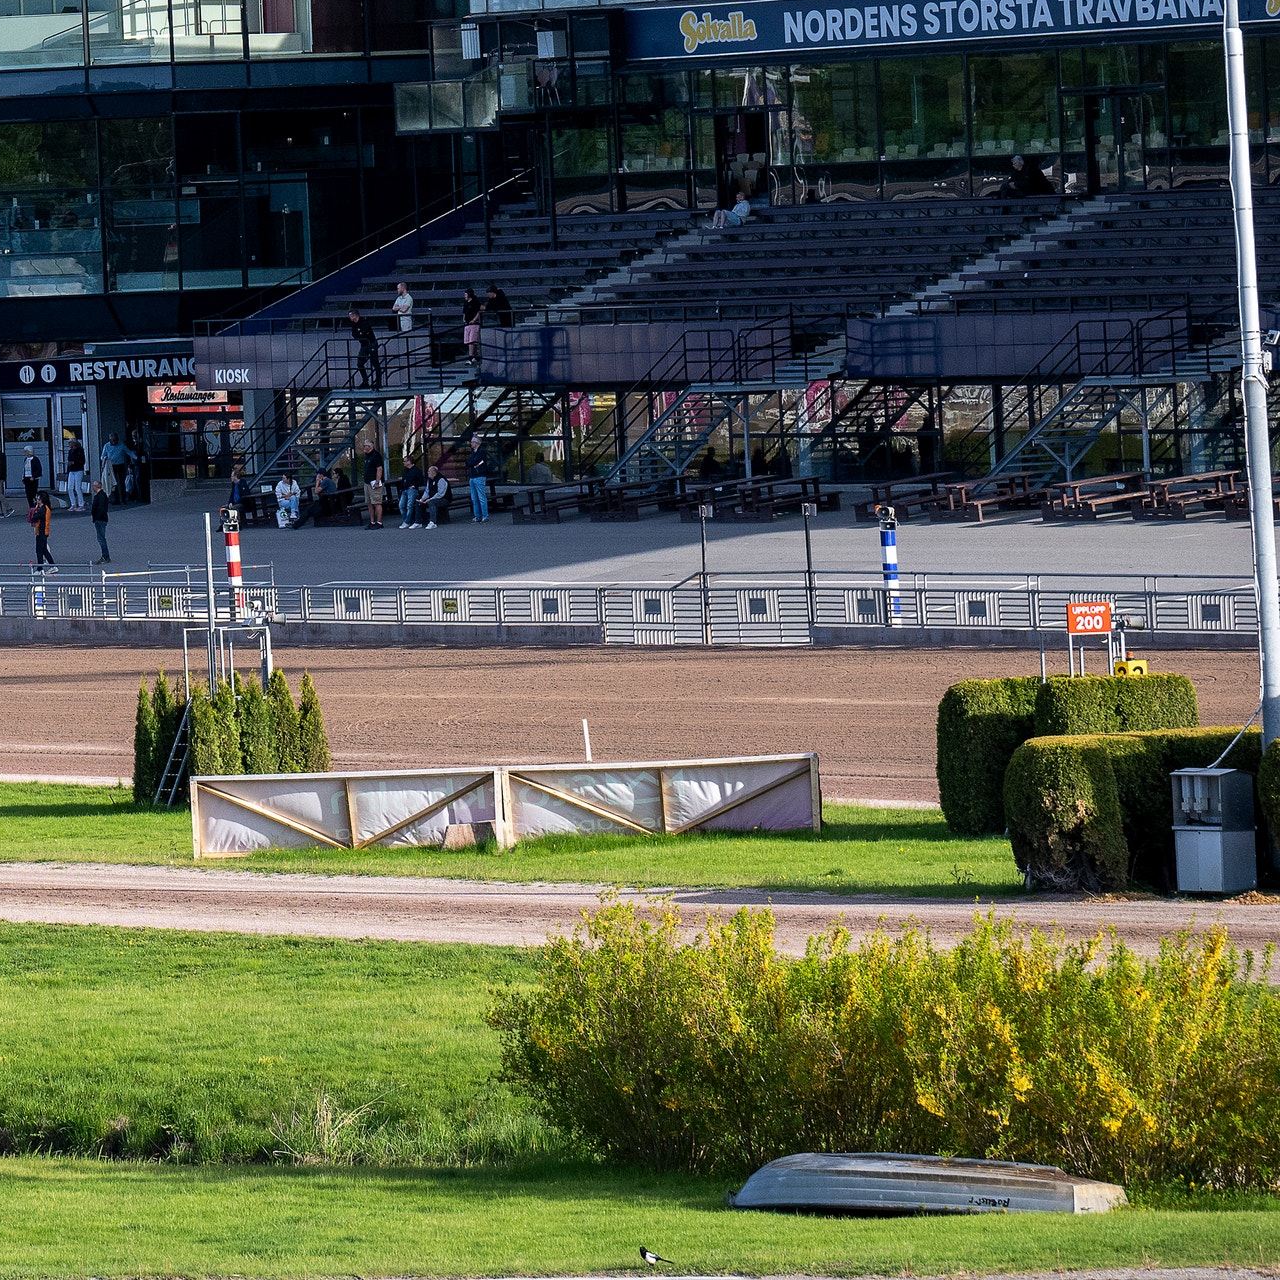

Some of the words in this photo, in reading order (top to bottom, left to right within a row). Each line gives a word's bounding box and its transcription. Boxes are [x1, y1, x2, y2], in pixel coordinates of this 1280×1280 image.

[679, 11, 757, 53] Solvalla
[783, 4, 917, 44] NORDENS
[215, 368, 249, 384] KIOSK
[1072, 605, 1106, 615] UPPLOPP
[1076, 615, 1103, 630] 200
